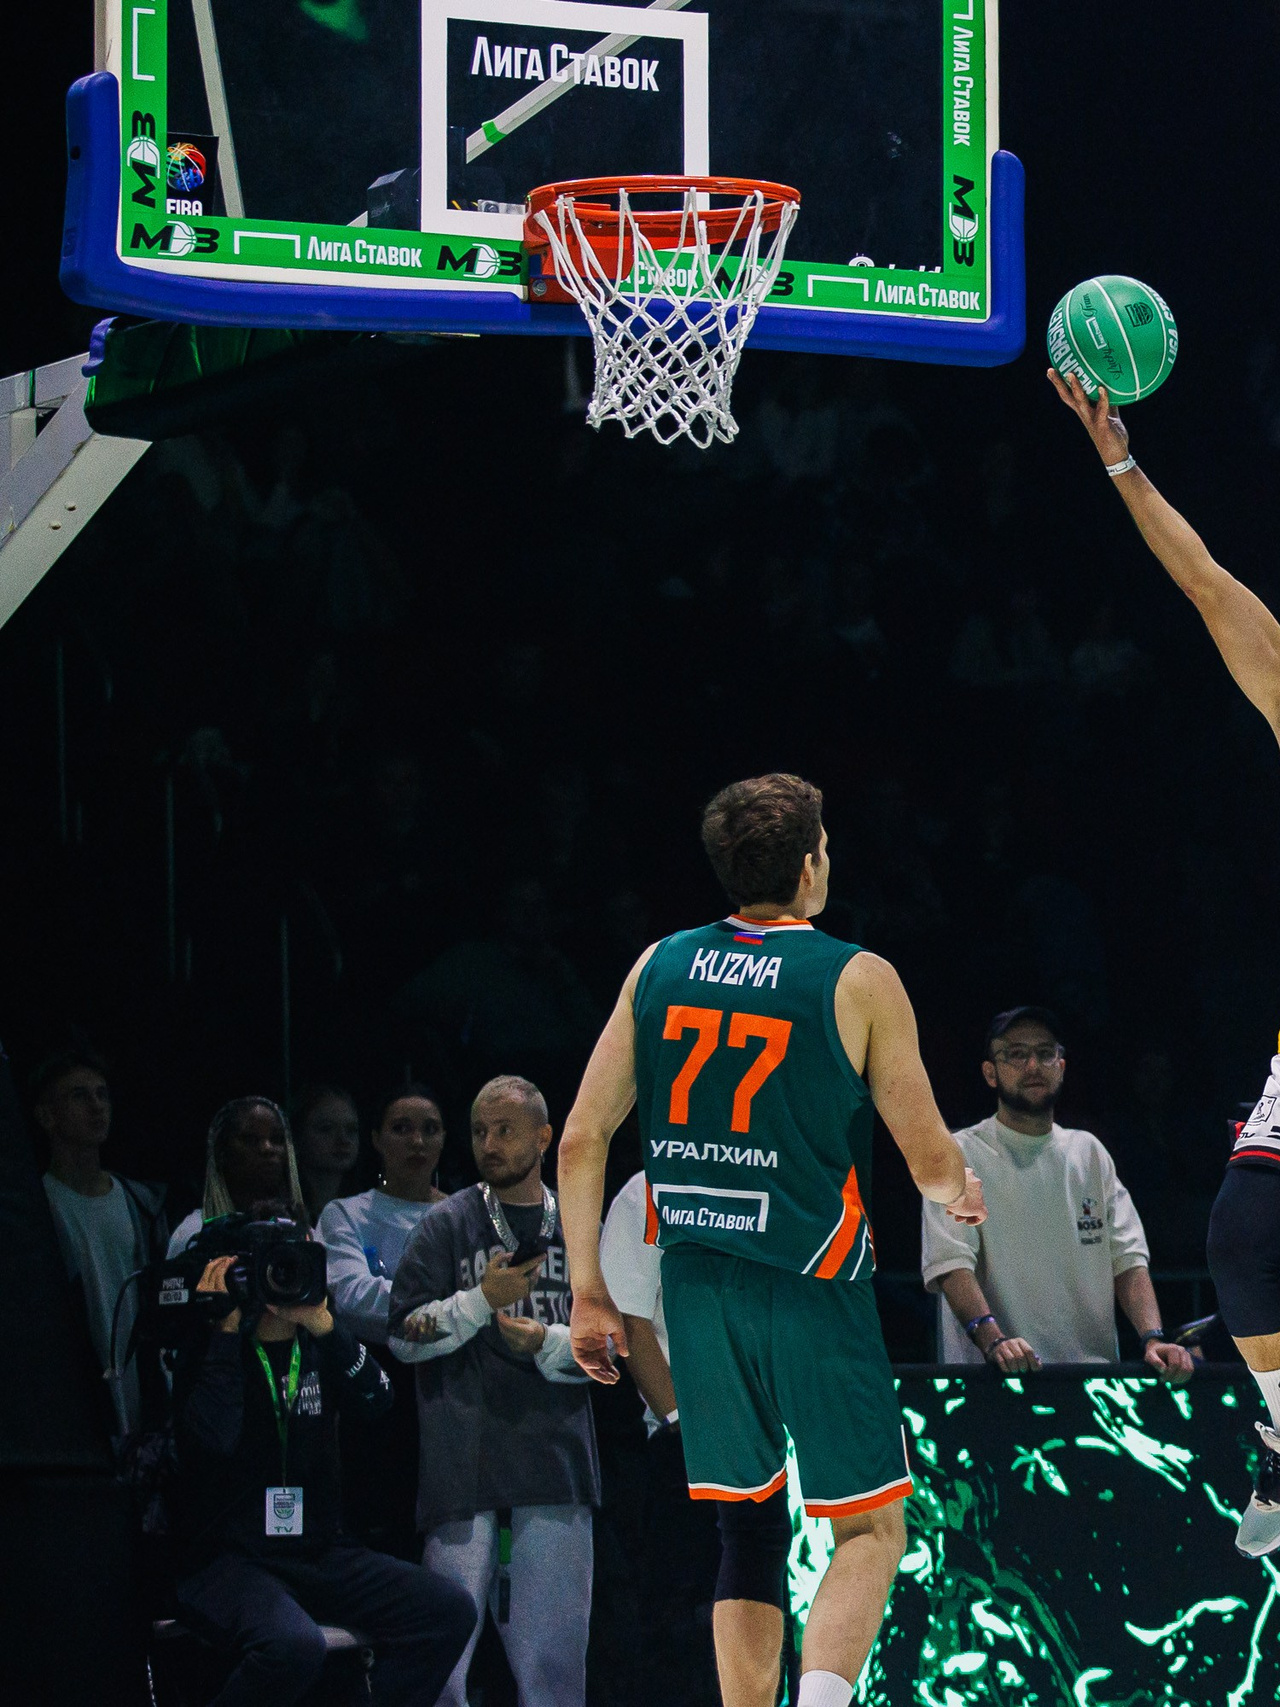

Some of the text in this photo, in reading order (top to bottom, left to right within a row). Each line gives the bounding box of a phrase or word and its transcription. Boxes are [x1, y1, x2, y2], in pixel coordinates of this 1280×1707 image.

[471, 36, 659, 92] ЛИГА СТАВОК
[953, 26, 974, 146] ЛИГА СТАВОК
[307, 236, 422, 268] ЛИГА СТАВОК
[875, 280, 980, 311] ЛИГА СТАВОК
[688, 948, 782, 989] KUZMA
[663, 1005, 793, 1133] 77
[650, 1139, 778, 1168] УРАЛХИМ
[662, 1206, 756, 1231] ЛИГА СТАВОК
